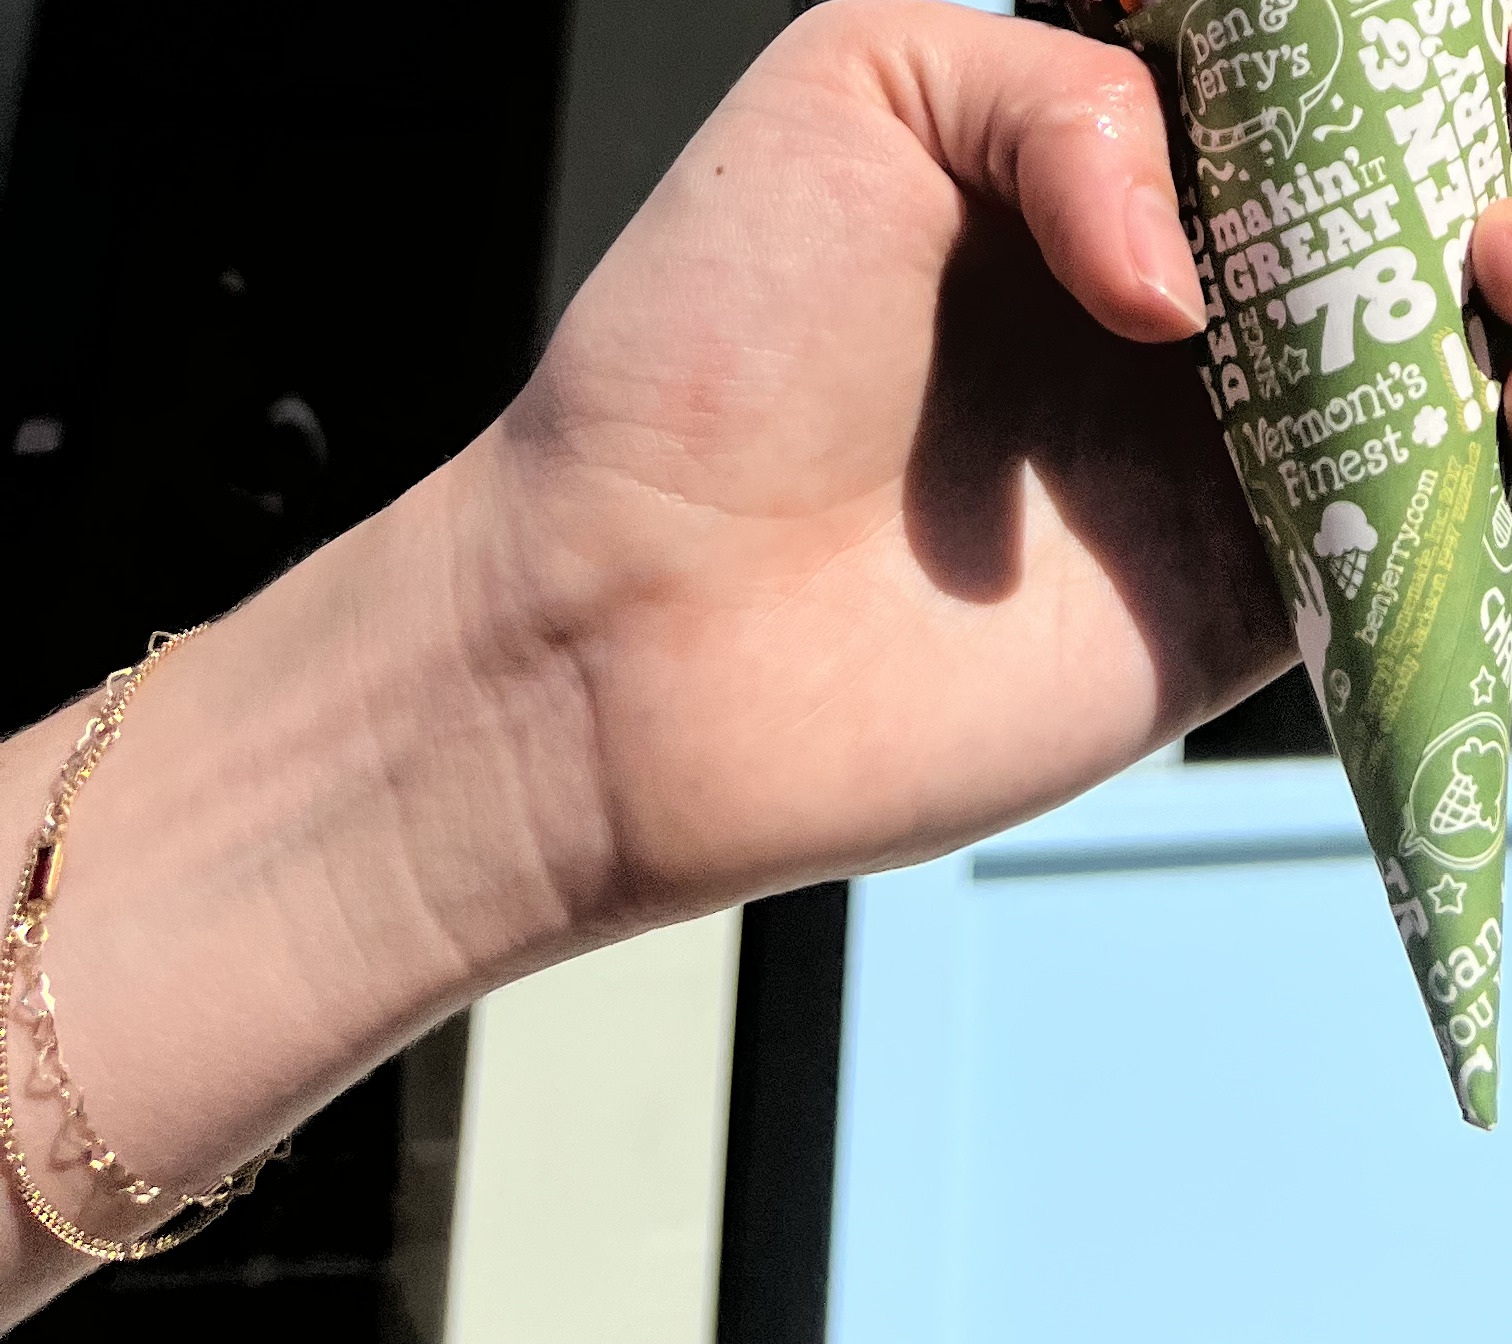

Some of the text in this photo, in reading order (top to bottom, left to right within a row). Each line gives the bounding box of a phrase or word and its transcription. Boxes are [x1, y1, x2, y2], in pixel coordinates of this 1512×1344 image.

[1186, 7, 1253, 65] ben
[1190, 41, 1311, 115] jerry's
[1209, 146, 1388, 253] makin' IT
[1223, 184, 1401, 302] GREAT
[1243, 360, 1429, 469] Vermont's
[1353, 468, 1438, 647] benjerry.com
